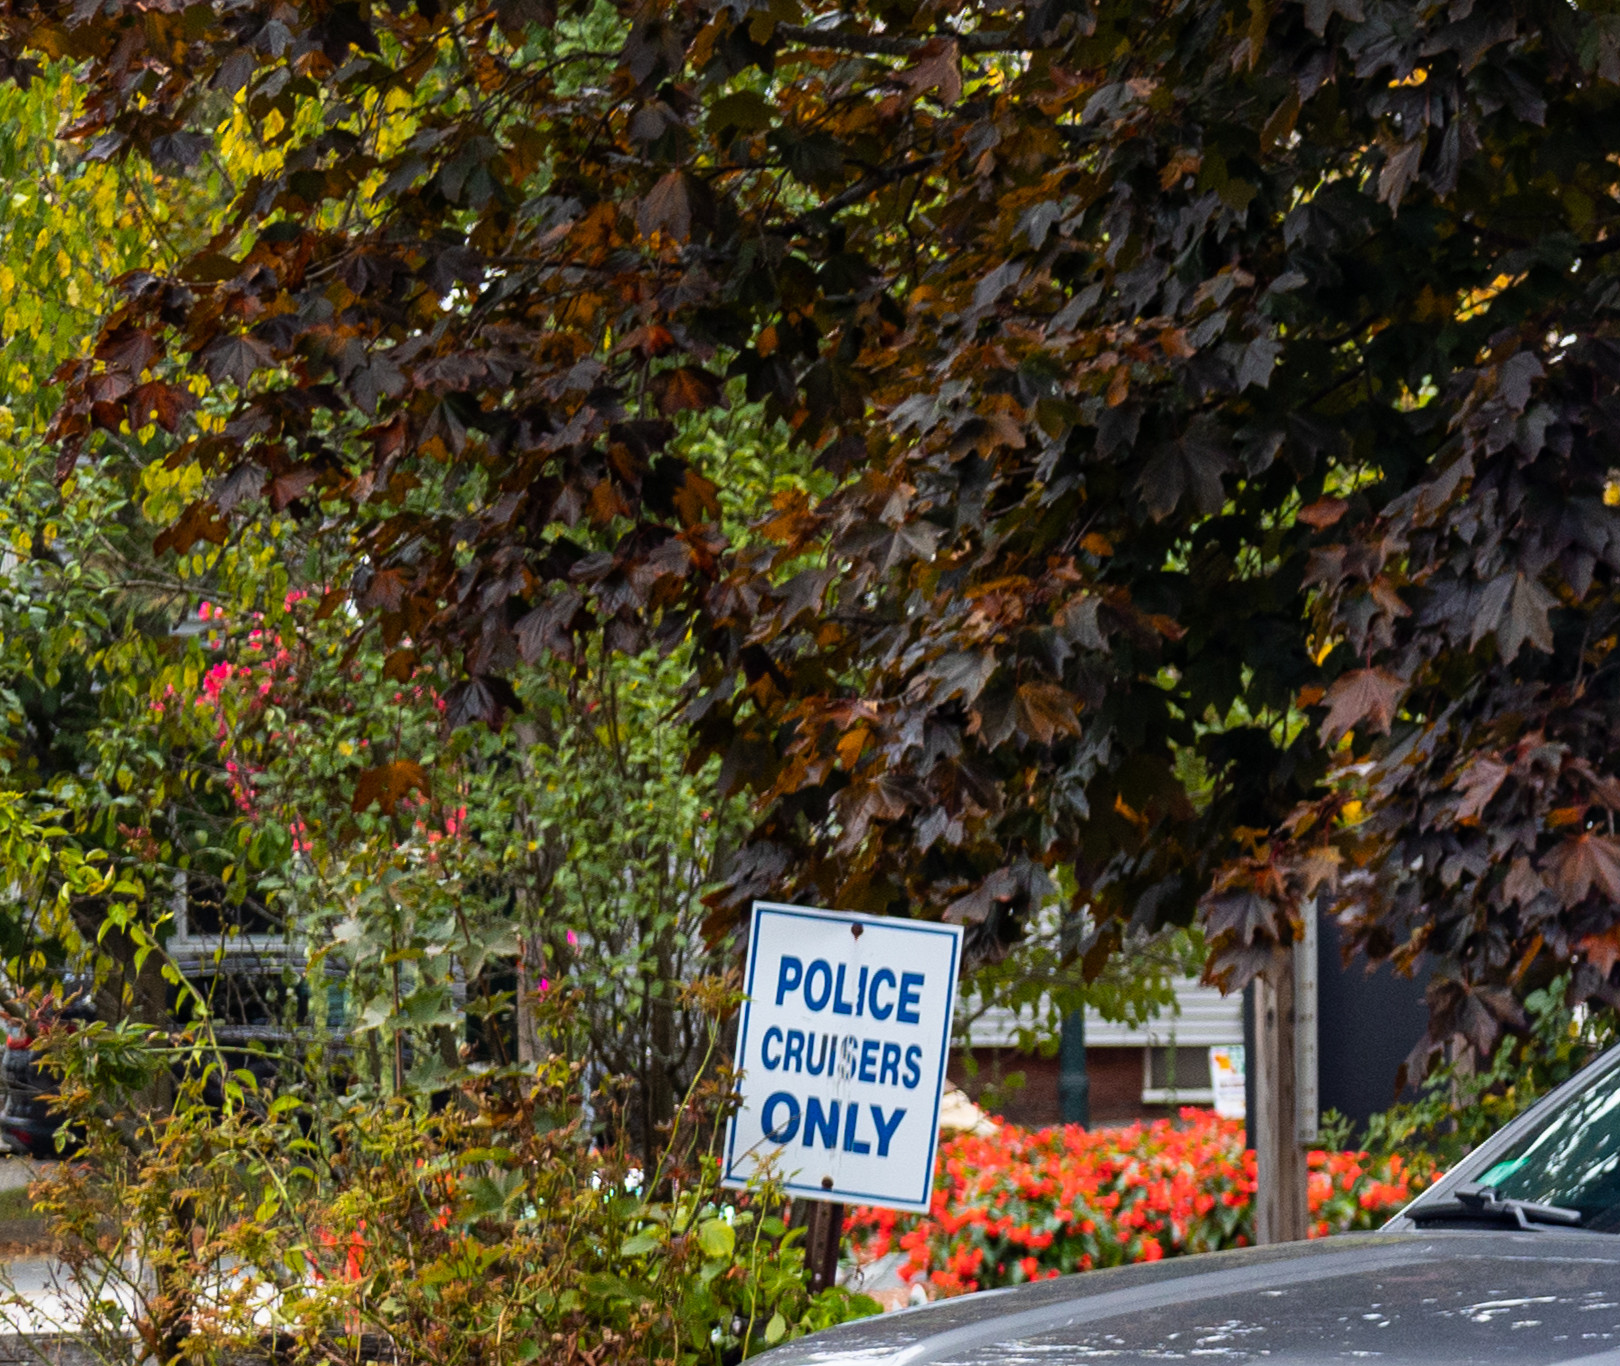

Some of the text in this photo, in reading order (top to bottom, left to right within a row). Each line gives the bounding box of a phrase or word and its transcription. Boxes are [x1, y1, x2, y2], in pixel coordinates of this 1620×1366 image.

[775, 955, 925, 1024] POLICE
[761, 1025, 923, 1090] CRUISERS
[761, 1091, 907, 1158] ONLY
